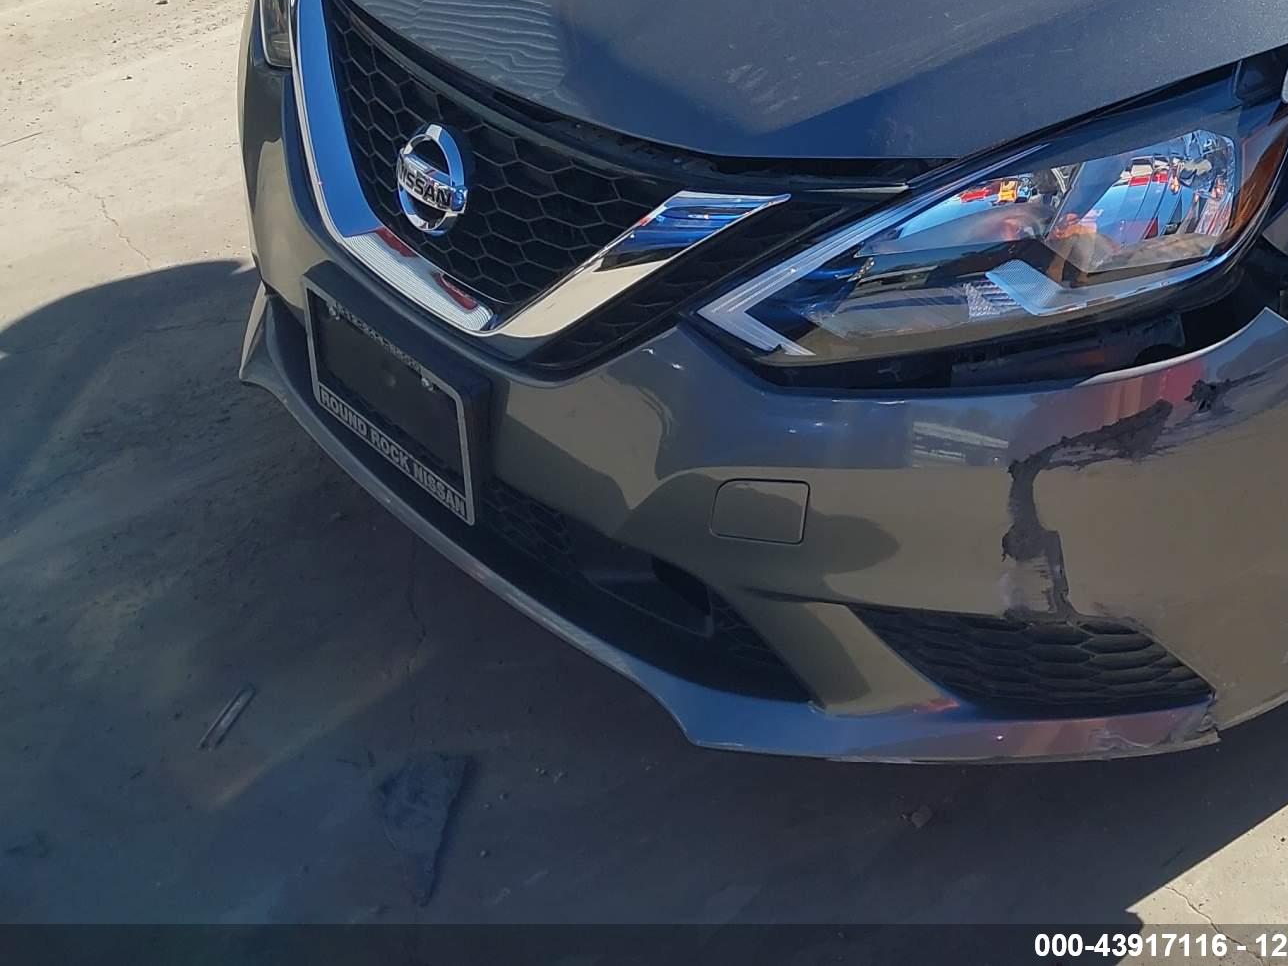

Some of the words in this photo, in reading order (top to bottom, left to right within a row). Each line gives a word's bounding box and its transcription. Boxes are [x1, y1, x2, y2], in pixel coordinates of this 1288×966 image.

[400, 156, 452, 206] NISSAN
[320, 388, 367, 436] ROUND
[371, 428, 410, 474] ROCK
[413, 464, 466, 518] NISSAN
